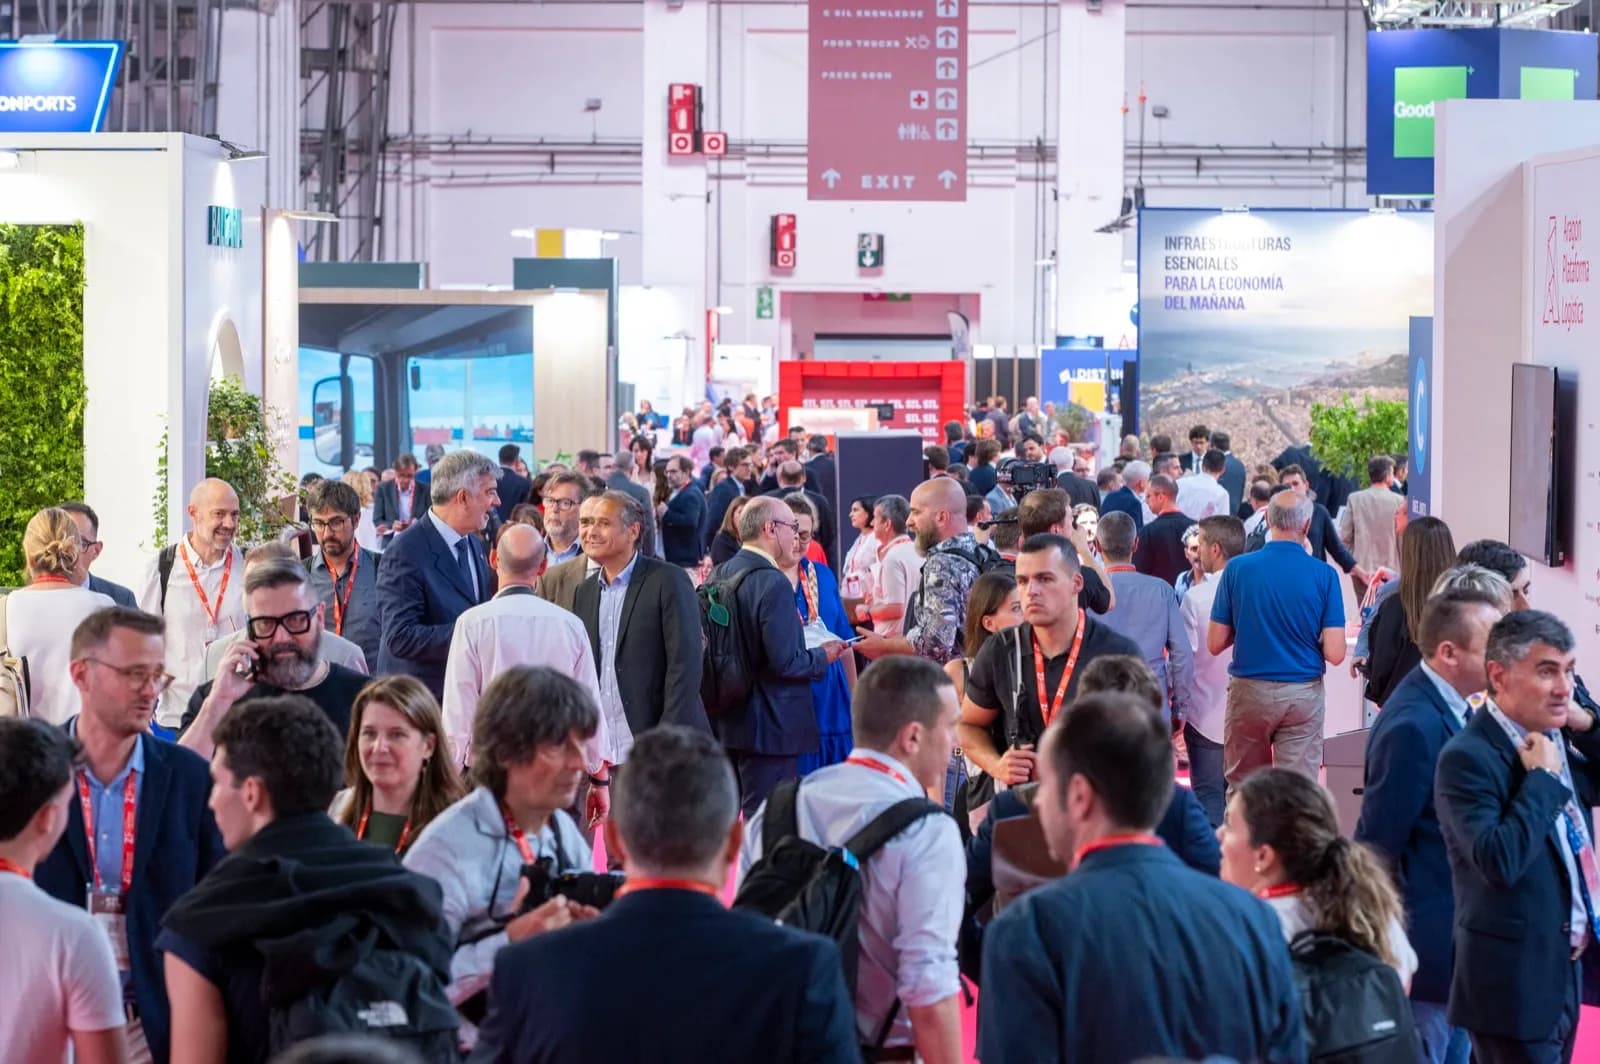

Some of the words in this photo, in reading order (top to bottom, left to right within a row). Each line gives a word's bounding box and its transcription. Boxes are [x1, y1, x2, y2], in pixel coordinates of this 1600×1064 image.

[1394, 101, 1435, 118] Good
[861, 174, 915, 189] EXIT
[1164, 235, 1292, 251] INFRAESTTURAS
[1164, 255, 1239, 271] ESENCIALES
[1164, 275, 1198, 291] PARA
[1200, 275, 1217, 291] LA
[1219, 272, 1284, 291] ECONOMÍA
[1164, 295, 1187, 311] DEL
[1190, 292, 1245, 311] MAÑANA
